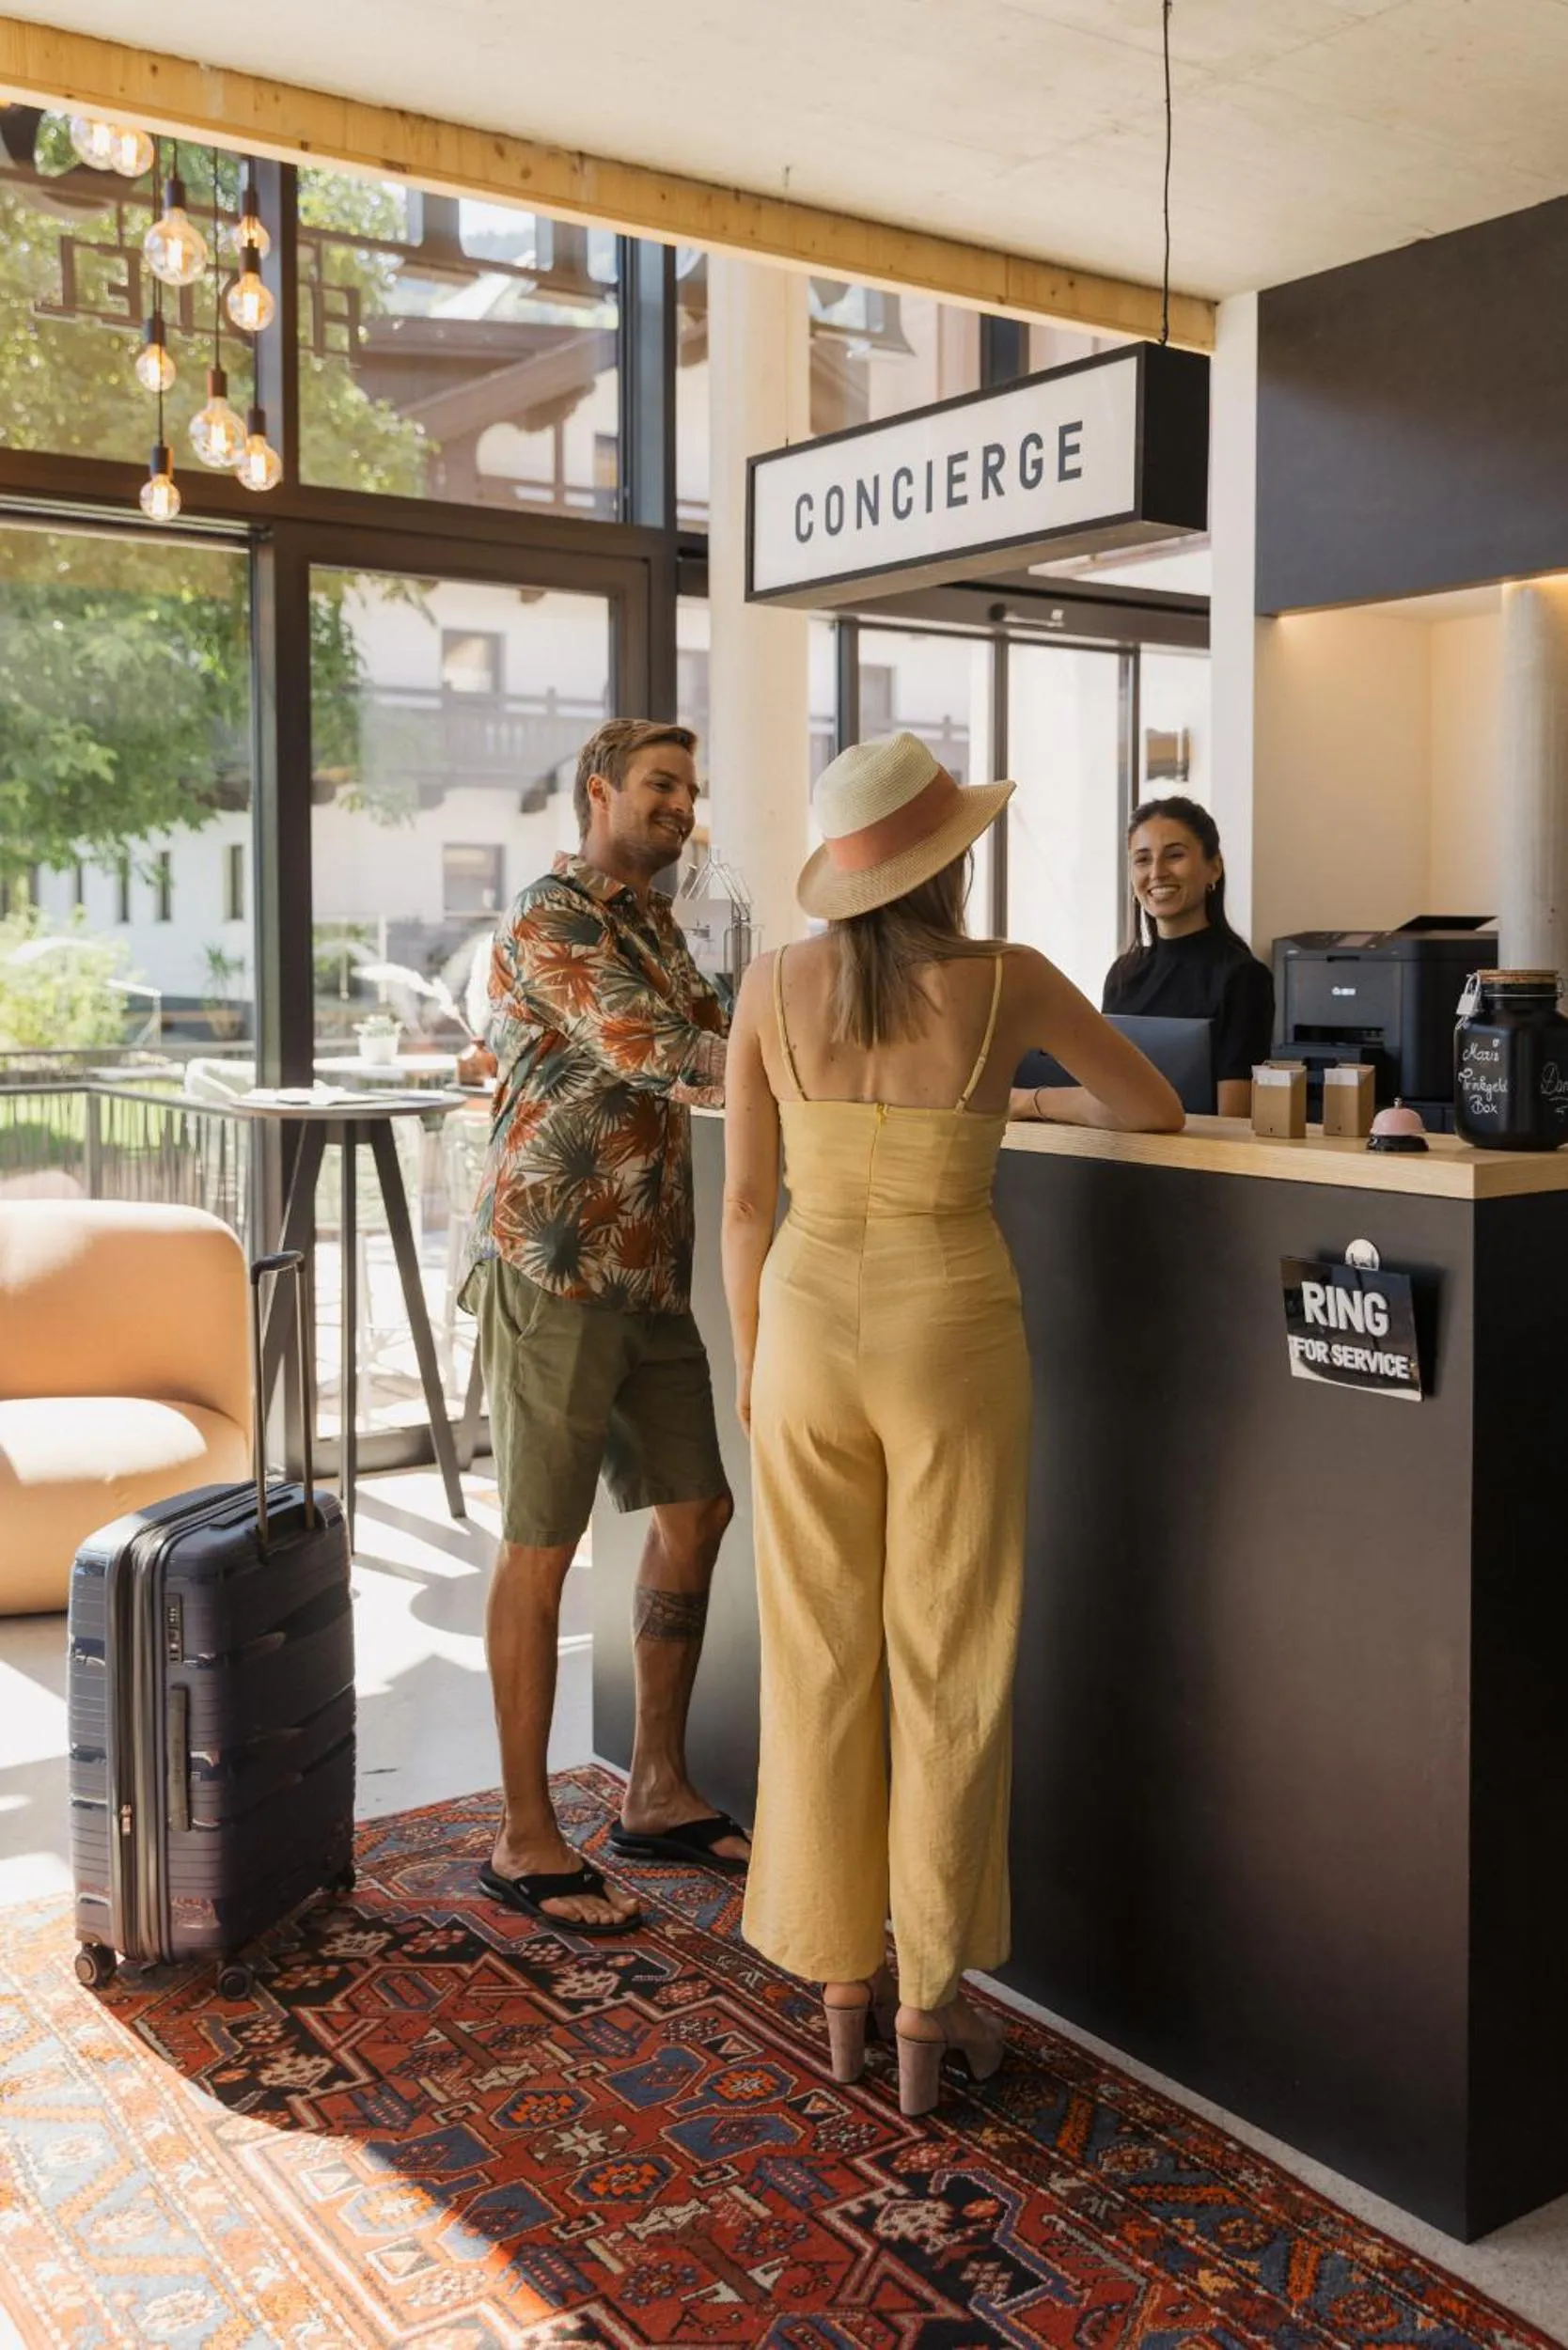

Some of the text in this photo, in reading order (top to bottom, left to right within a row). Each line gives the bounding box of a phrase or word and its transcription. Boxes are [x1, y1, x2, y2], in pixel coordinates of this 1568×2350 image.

[794, 420, 1083, 543] CONCIERGE
[1469, 1094, 1498, 1115] Box
[1301, 1281, 1389, 1337] RING
[1291, 1336, 1410, 1379] FOR SERVICE
